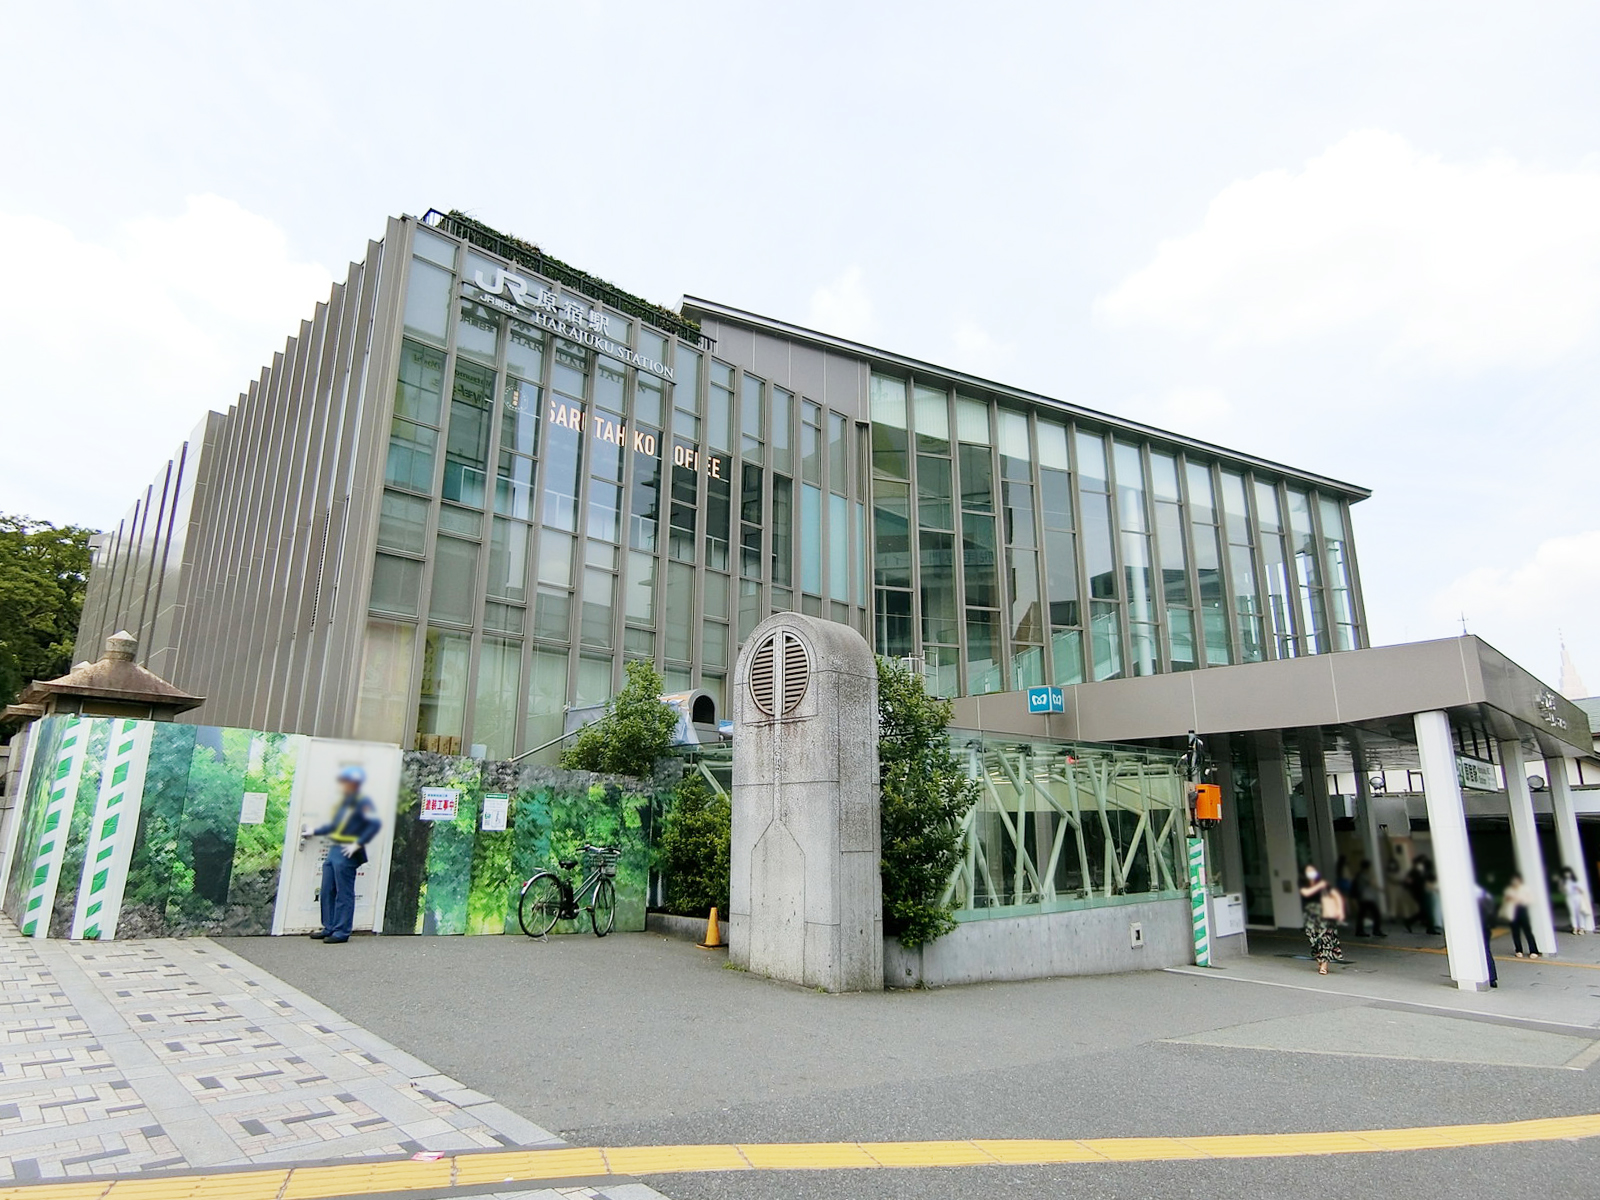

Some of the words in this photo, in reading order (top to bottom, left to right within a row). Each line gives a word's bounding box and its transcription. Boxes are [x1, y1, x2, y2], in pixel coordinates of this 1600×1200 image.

[475, 268, 528, 307] JR
[534, 288, 610, 336] 原宿駅
[480, 293, 520, 315] JR東日本
[534, 311, 614, 354] HARAJUKU
[616, 346, 674, 379] STATION
[549, 400, 656, 456] SARTAHKO
[674, 445, 721, 479] OFEE
